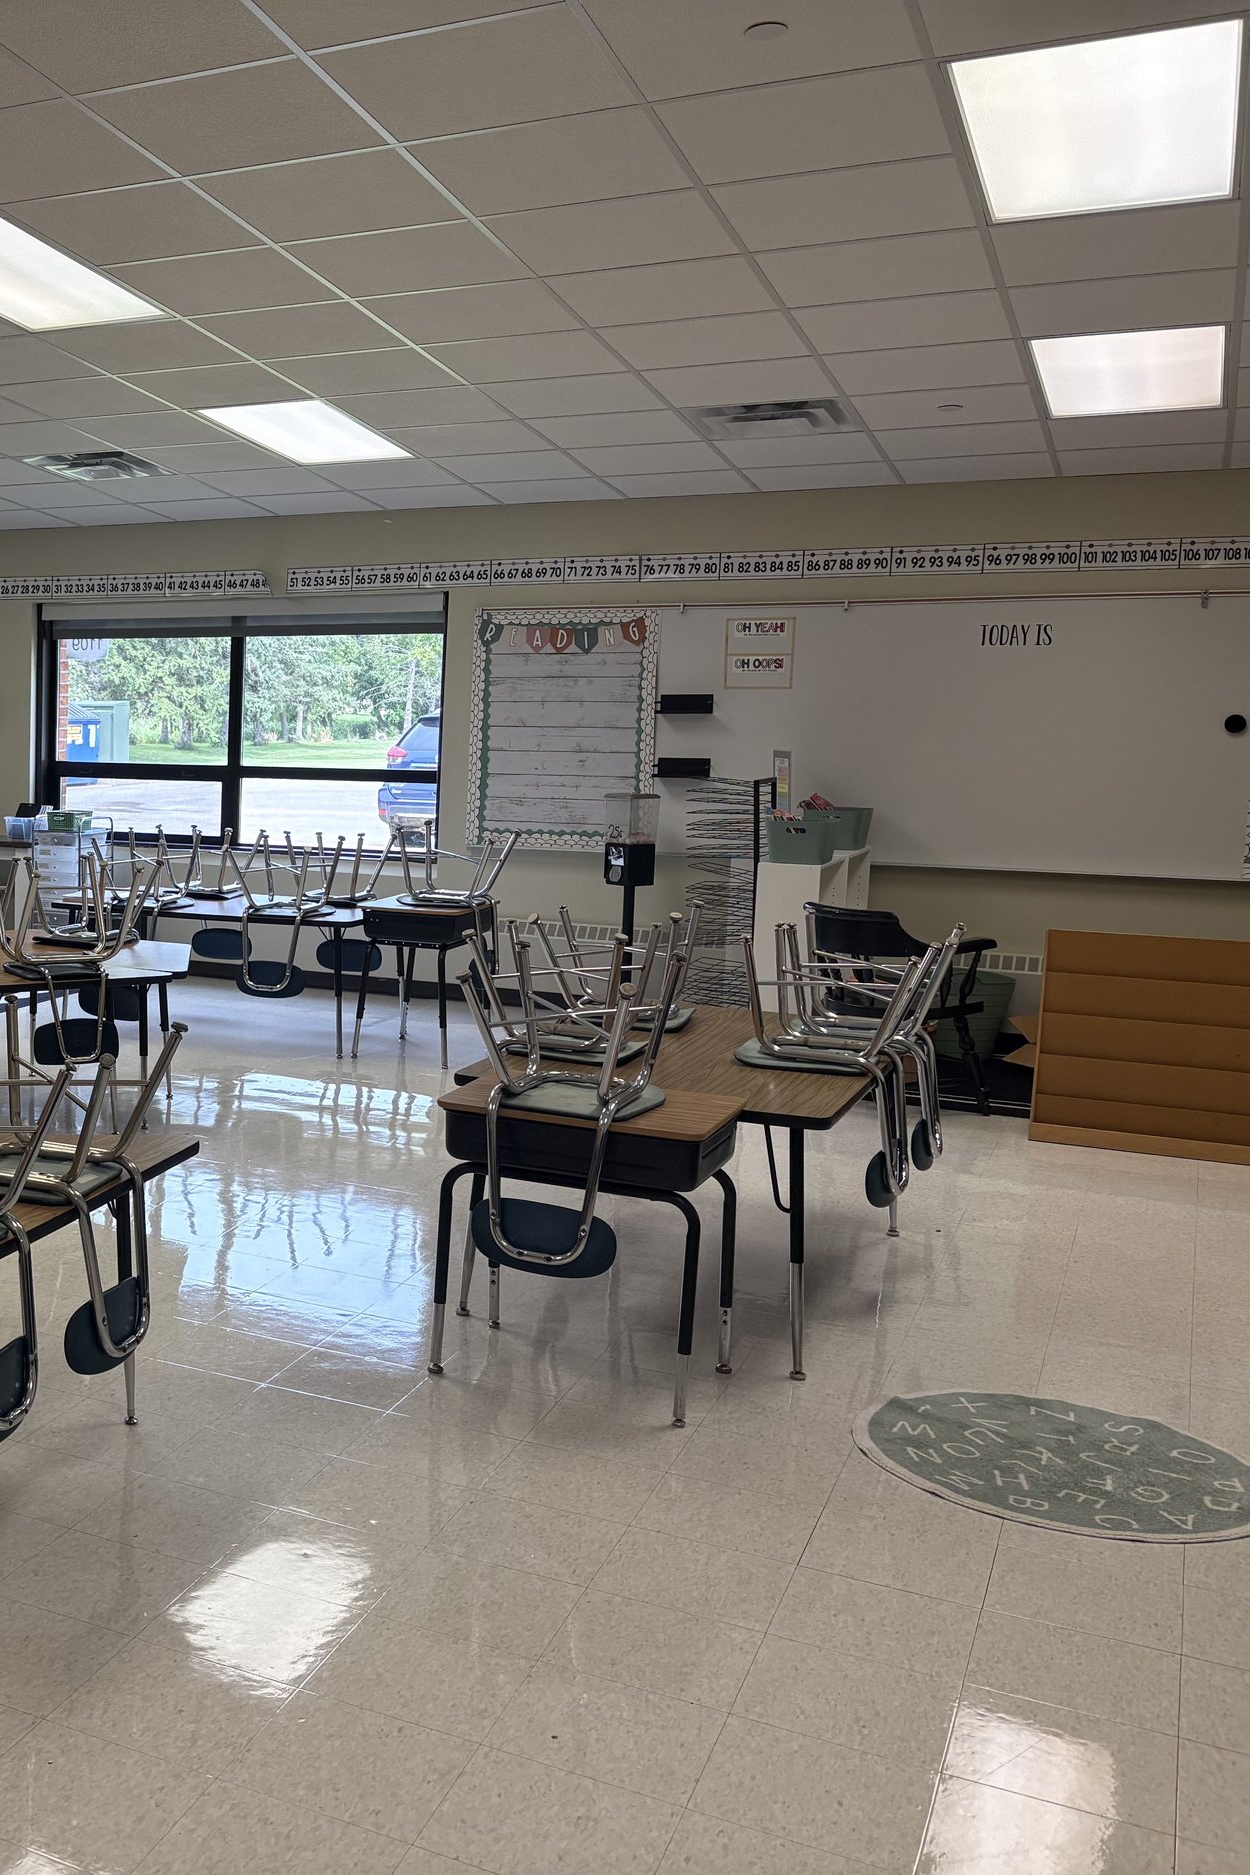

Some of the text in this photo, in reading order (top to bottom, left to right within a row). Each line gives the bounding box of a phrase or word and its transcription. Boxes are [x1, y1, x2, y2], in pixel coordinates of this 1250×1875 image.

[289, 577, 298, 588] 51
[301, 576, 312, 587] 52
[313, 576, 324, 587] 53
[326, 576, 337, 586] 54
[339, 575, 350, 586] 55
[354, 574, 366, 585] 56
[367, 574, 378, 584] 57
[380, 573, 391, 584] 58
[393, 573, 405, 583] 59
[406, 572, 418, 583] 60
[422, 572, 432, 582] 61
[435, 571, 446, 582] 62
[450, 570, 460, 581] 63
[462, 570, 475, 581] 64
[476, 569, 488, 580] 65
[493, 569, 505, 580] 66
[507, 568, 519, 579] 67
[521, 568, 533, 579] 68
[535, 567, 547, 578] 69
[549, 567, 562, 578] 70
[567, 566, 577, 577] 71
[580, 566, 593, 577] 72
[595, 565, 607, 576] 73
[610, 565, 622, 576] 74
[625, 564, 637, 576] 75
[643, 564, 655, 576] 76
[657, 564, 671, 575] 77
[673, 563, 685, 575] 78
[688, 563, 701, 574] 79
[704, 562, 717, 574] 80
[723, 562, 734, 573] 81
[737, 562, 751, 573] 82
[754, 561, 767, 573] 83
[769, 561, 784, 572] 84
[786, 560, 800, 572] 85
[806, 560, 821, 571] 86
[823, 559, 837, 571] 87
[839, 558, 853, 570] 88
[856, 558, 871, 570] 89
[873, 557, 888, 569] 90
[895, 557, 906, 569] 91
[911, 556, 926, 568] 92
[929, 556, 943, 568] 93
[946, 555, 962, 567] 94
[965, 555, 980, 567] 95
[987, 554, 1002, 566] 96
[1005, 553, 1020, 566] 97
[1022, 553, 1037, 565] 98
[1039, 552, 1055, 565] 99
[1057, 552, 1077, 564] 100
[1083, 551, 1098, 564] 101
[1101, 551, 1118, 563] 102
[1120, 550, 1137, 563] 103
[1139, 549, 1158, 562] 104
[1159, 549, 1178, 562] 105
[1183, 548, 1201, 561] 106
[1203, 548, 1222, 561] 107
[1223, 547, 1241, 560] 108
[1, 585, 10, 595] 26
[11, 585, 20, 594] 27
[21, 584, 30, 594] 28
[31, 584, 40, 594] 29
[41, 584, 51, 594] 30
[54, 584, 62, 594] 31
[64, 584, 73, 594] 32
[75, 583, 84, 593] 33
[85, 583, 95, 593] 34
[96, 583, 106, 593] 35
[109, 583, 119, 592] 36
[120, 582, 130, 592] 37
[131, 582, 141, 592] 38
[142, 582, 153, 592] 39
[153, 581, 164, 591] 40
[167, 581, 175, 591] 41
[177, 580, 188, 591] 42
[189, 580, 199, 590] 43
[201, 580, 211, 590] 44
[212, 580, 223, 590] 45
[227, 579, 237, 589] 46
[238, 579, 249, 589] 47
[250, 578, 260, 589] 48
[483, 622, 639, 649] READING
[735, 621, 786, 633] OH YEAH!
[980, 623, 1053, 646] TODAY IS
[734, 658, 750, 669] OH
[951, 1397, 989, 1413] X
[1104, 1421, 1144, 1436] S
[1158, 1510, 1195, 1530] A
